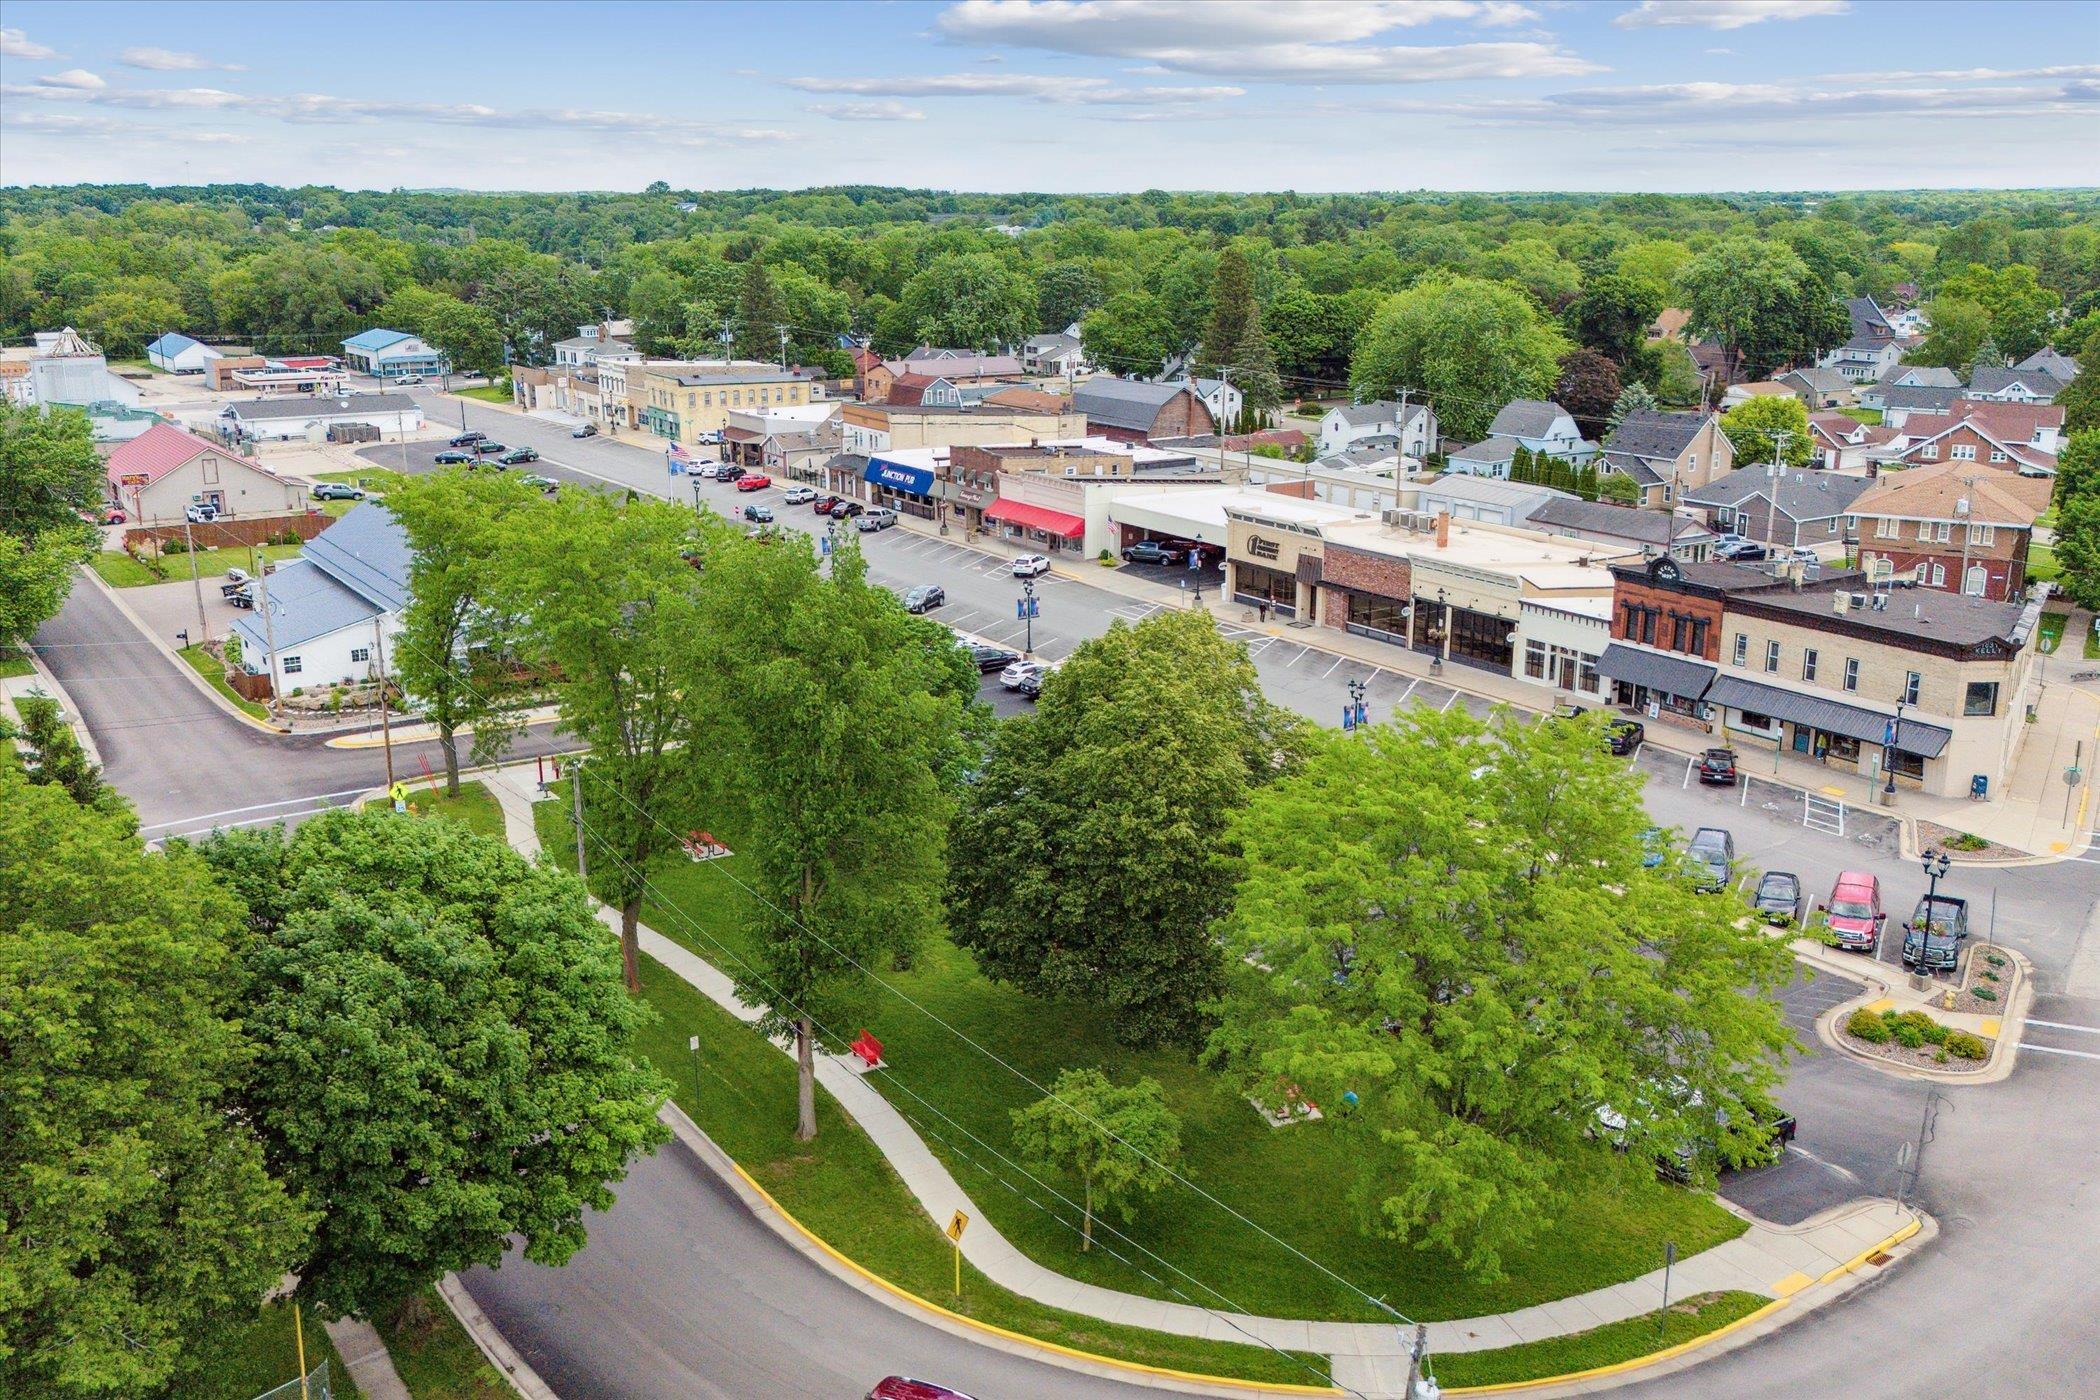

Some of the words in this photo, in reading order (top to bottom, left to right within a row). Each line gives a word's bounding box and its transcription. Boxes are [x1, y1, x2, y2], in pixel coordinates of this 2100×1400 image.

[881, 469, 905, 482] JUNCTION
[904, 474, 915, 485] PUB
[1256, 550, 1278, 560] BANK
